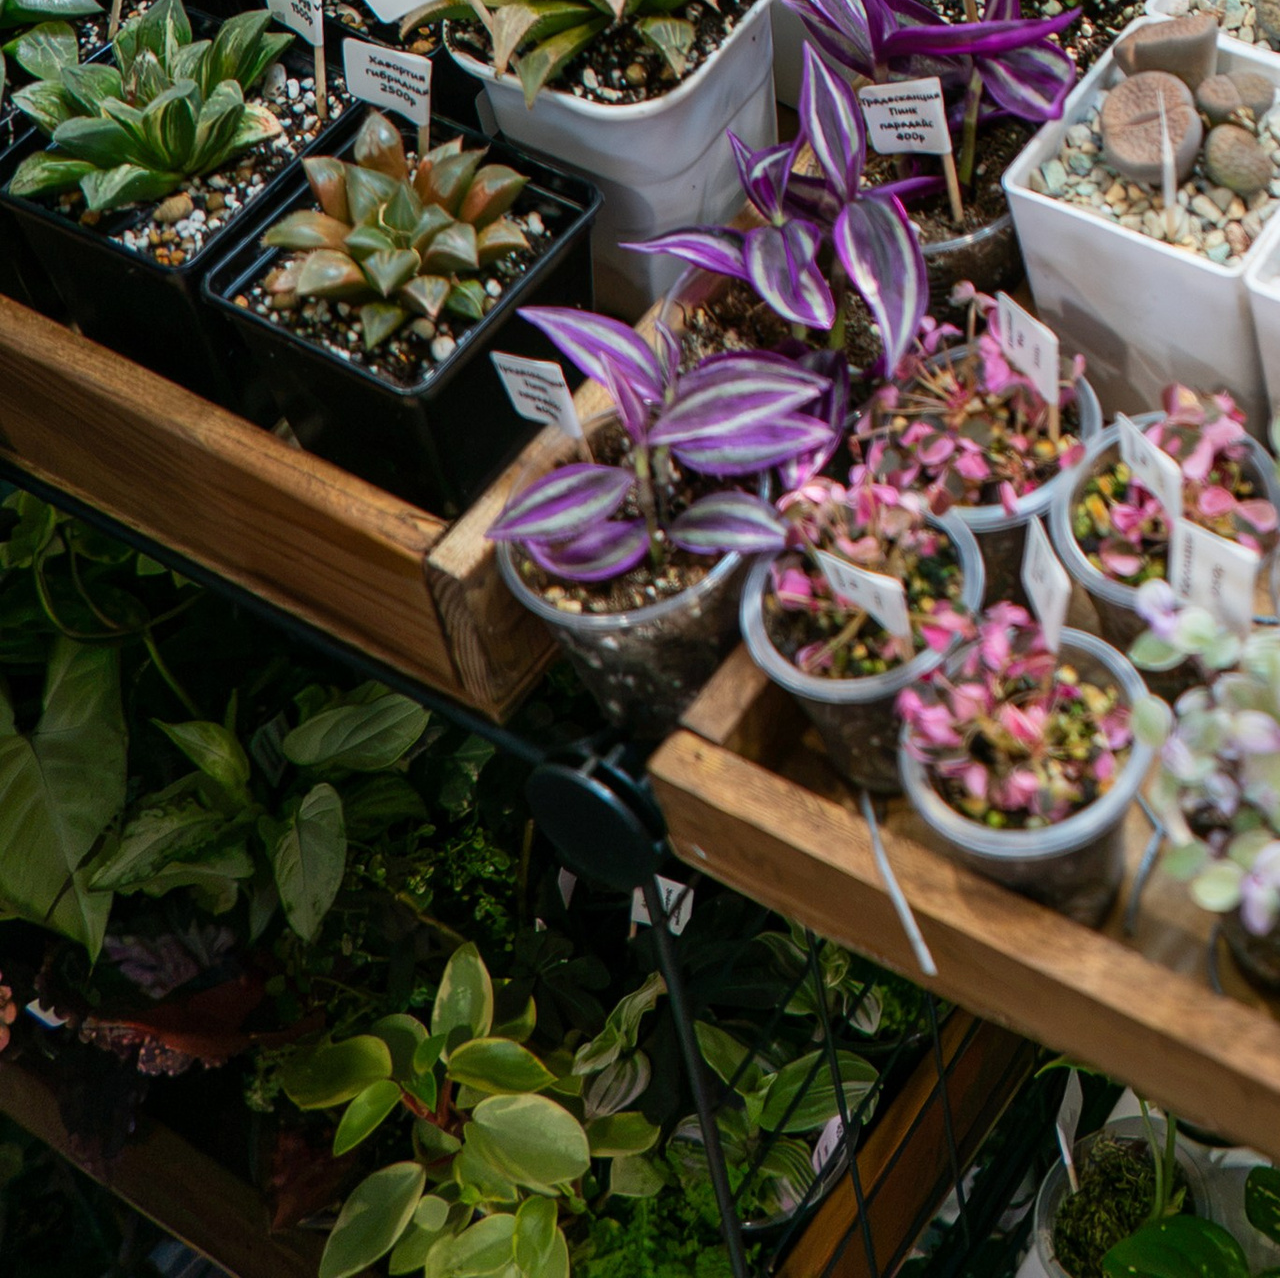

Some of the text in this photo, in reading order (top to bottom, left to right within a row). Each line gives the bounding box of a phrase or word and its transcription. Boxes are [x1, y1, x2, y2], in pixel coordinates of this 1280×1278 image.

[290, 1, 314, 27] 1500р
[368, 54, 426, 82] Хавортия
[365, 66, 430, 96] гибридная
[380, 83, 416, 106] 2500р
[888, 106, 917, 116] Пинк
[879, 118, 934, 131] парадайс
